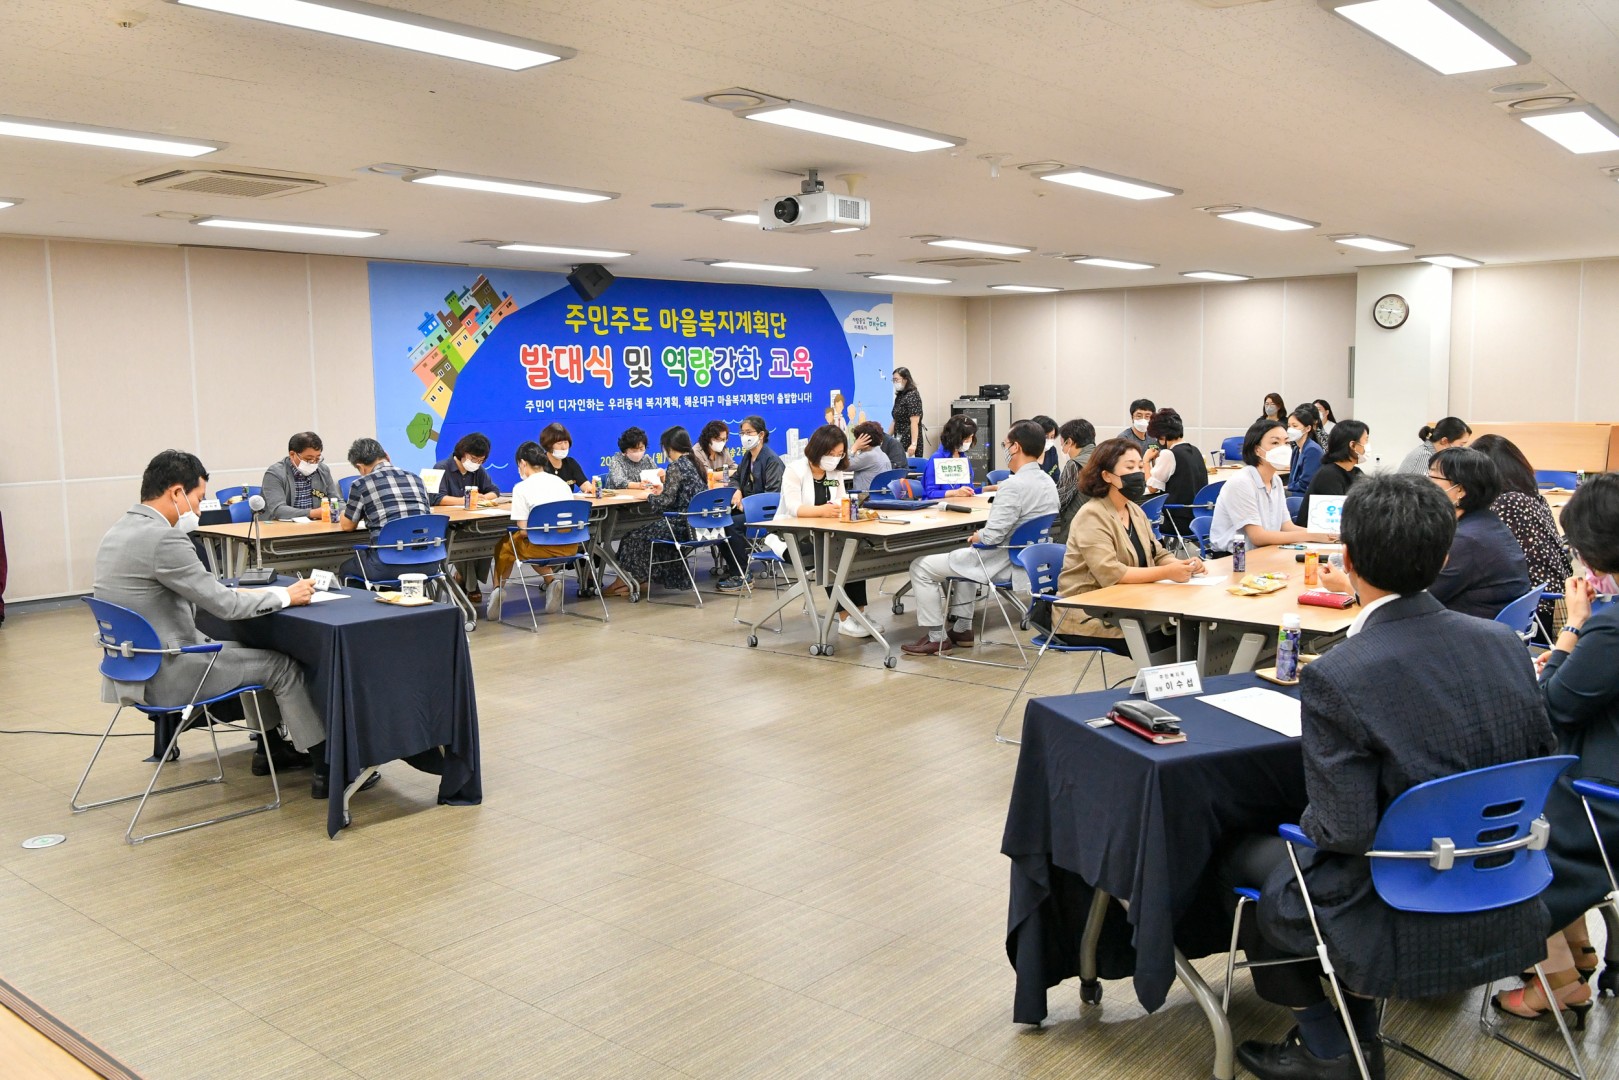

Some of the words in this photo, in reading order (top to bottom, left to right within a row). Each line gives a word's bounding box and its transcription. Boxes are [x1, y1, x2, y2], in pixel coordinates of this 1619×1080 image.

[565, 304, 653, 335] 주민주도
[659, 308, 787, 339] 마을복지계획단
[519, 343, 613, 390] 발대식
[623, 345, 653, 388] 및
[661, 345, 762, 387] 역량강화
[768, 345, 813, 384] 교육
[525, 400, 555, 413] 주민이
[558, 399, 605, 412] 디자인하는
[608, 397, 643, 410] 우리동네
[645, 396, 682, 410] 복지계획,
[684, 395, 715, 408] 해운대구
[717, 393, 775, 406] 마을복지계획단이
[777, 392, 813, 404] 출발합니다!
[727, 446, 747, 458] 송2동
